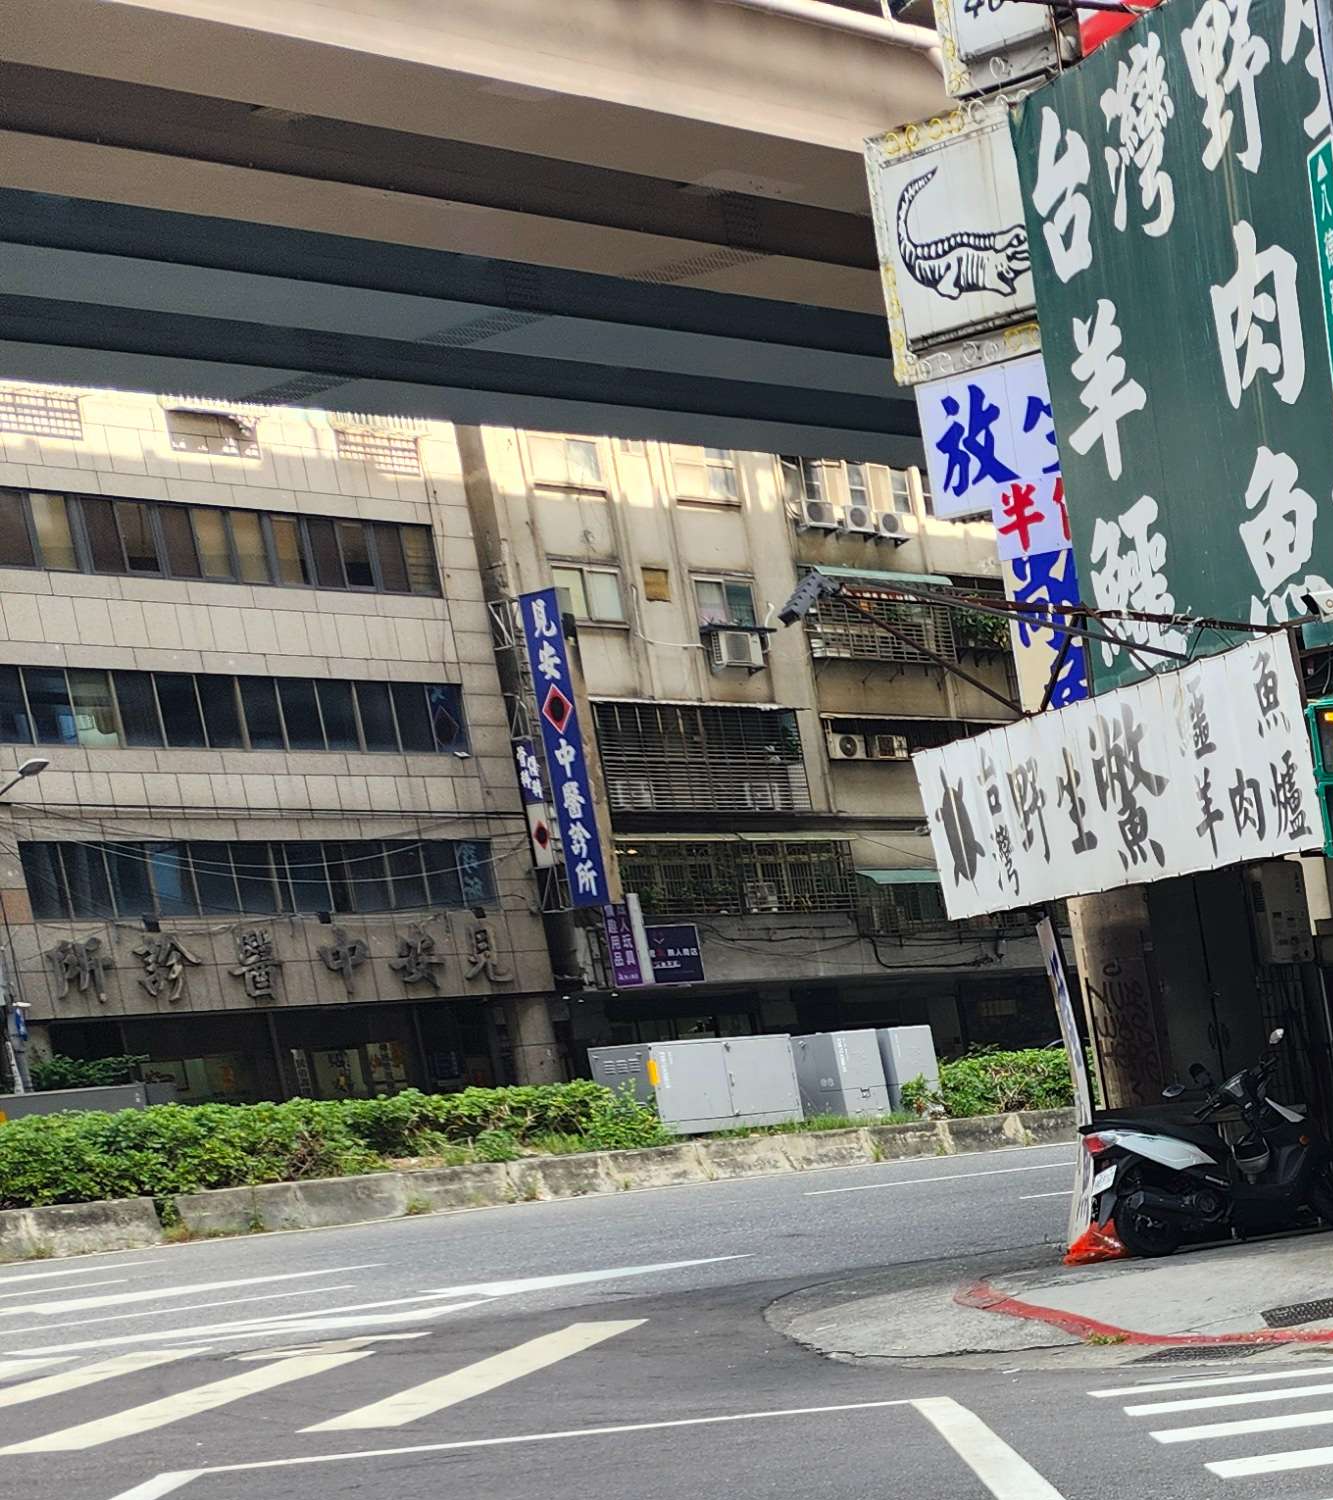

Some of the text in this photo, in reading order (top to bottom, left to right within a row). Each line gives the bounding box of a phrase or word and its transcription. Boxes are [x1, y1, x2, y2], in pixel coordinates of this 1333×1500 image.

[998, 482, 1071, 552] 半
[531, 598, 599, 897] 見安 中醫診所
[1194, 750, 1313, 859] 羊肉爐
